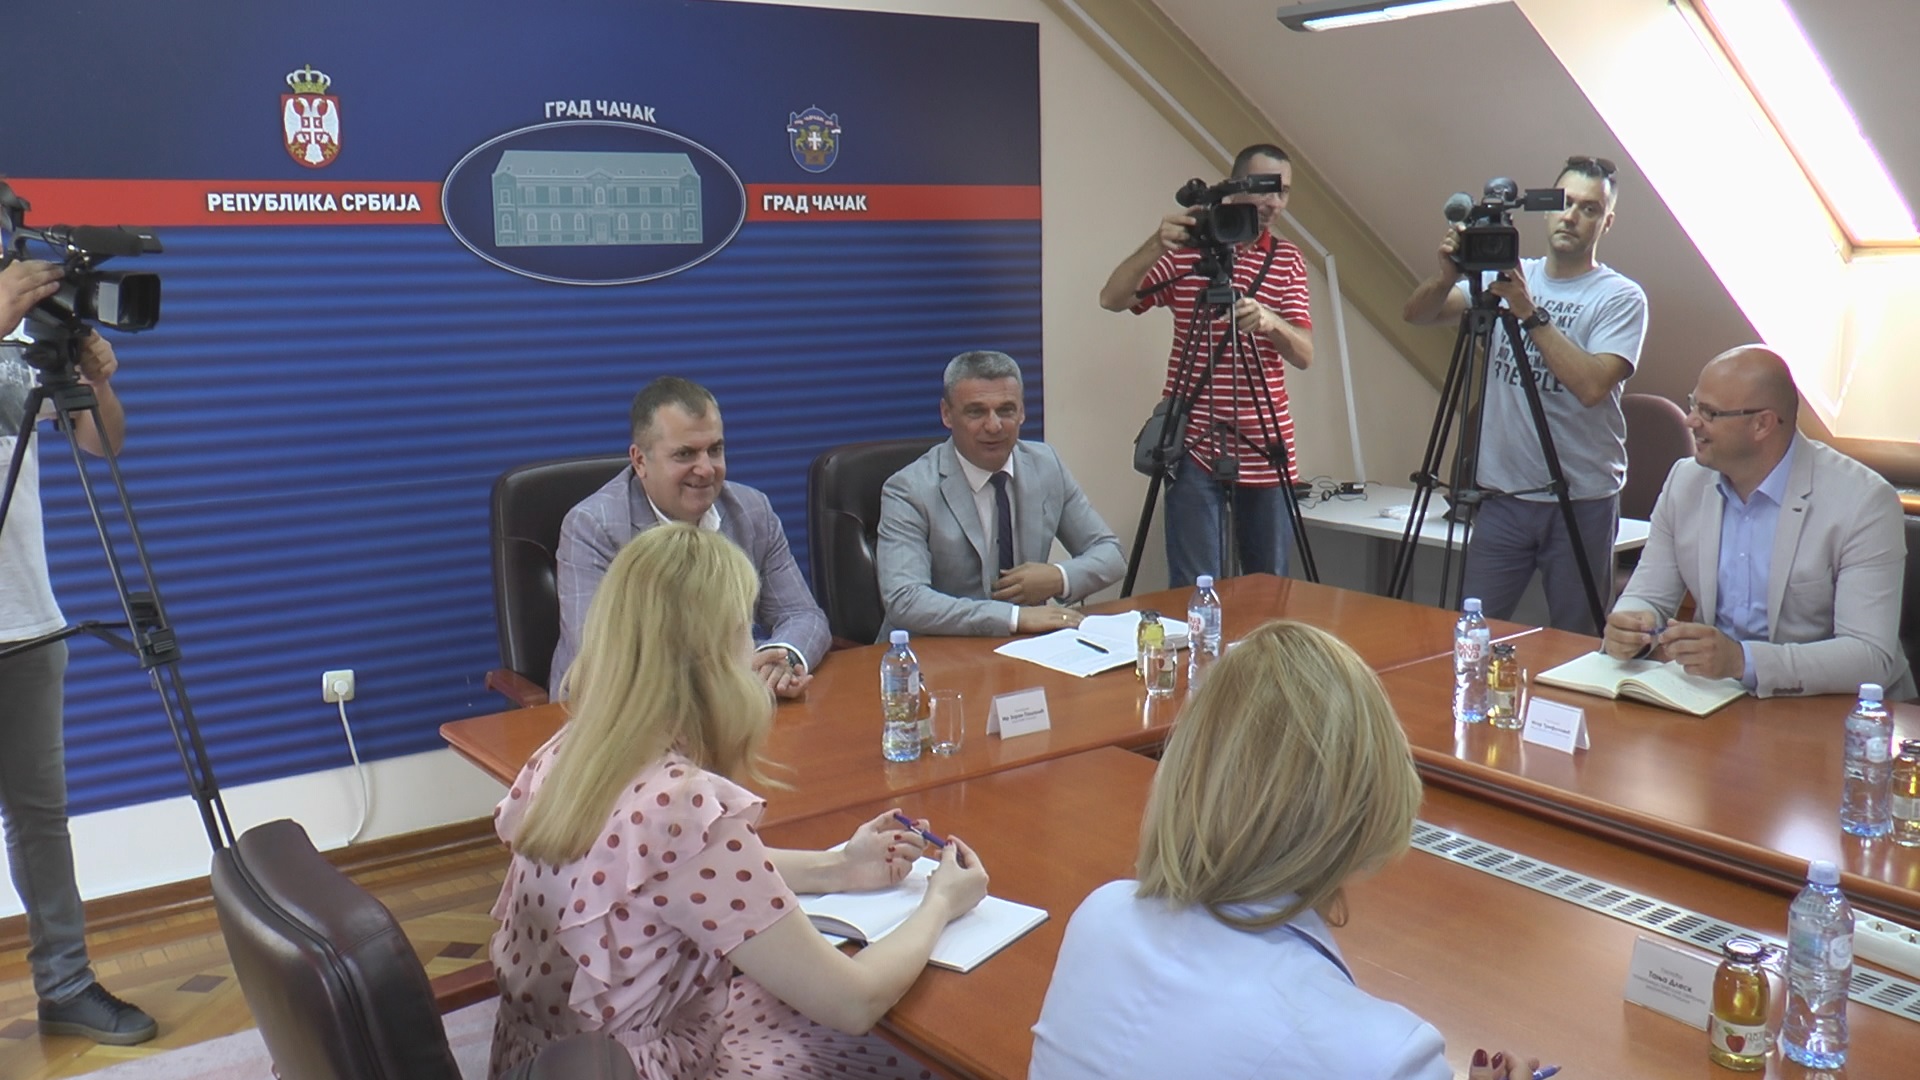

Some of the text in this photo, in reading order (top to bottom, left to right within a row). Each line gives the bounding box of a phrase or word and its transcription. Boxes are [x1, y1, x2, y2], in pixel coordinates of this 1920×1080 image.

[545, 99, 656, 124] ГРАД ЧАЧАК
[207, 193, 421, 212] РЕПУБЛИКА СРБИЈА
[763, 194, 867, 214] ГРАД ЧАЧАК
[1544, 300, 1584, 314] CARE
[1556, 315, 1577, 329] MY
[1503, 363, 1563, 392] PEPLE
